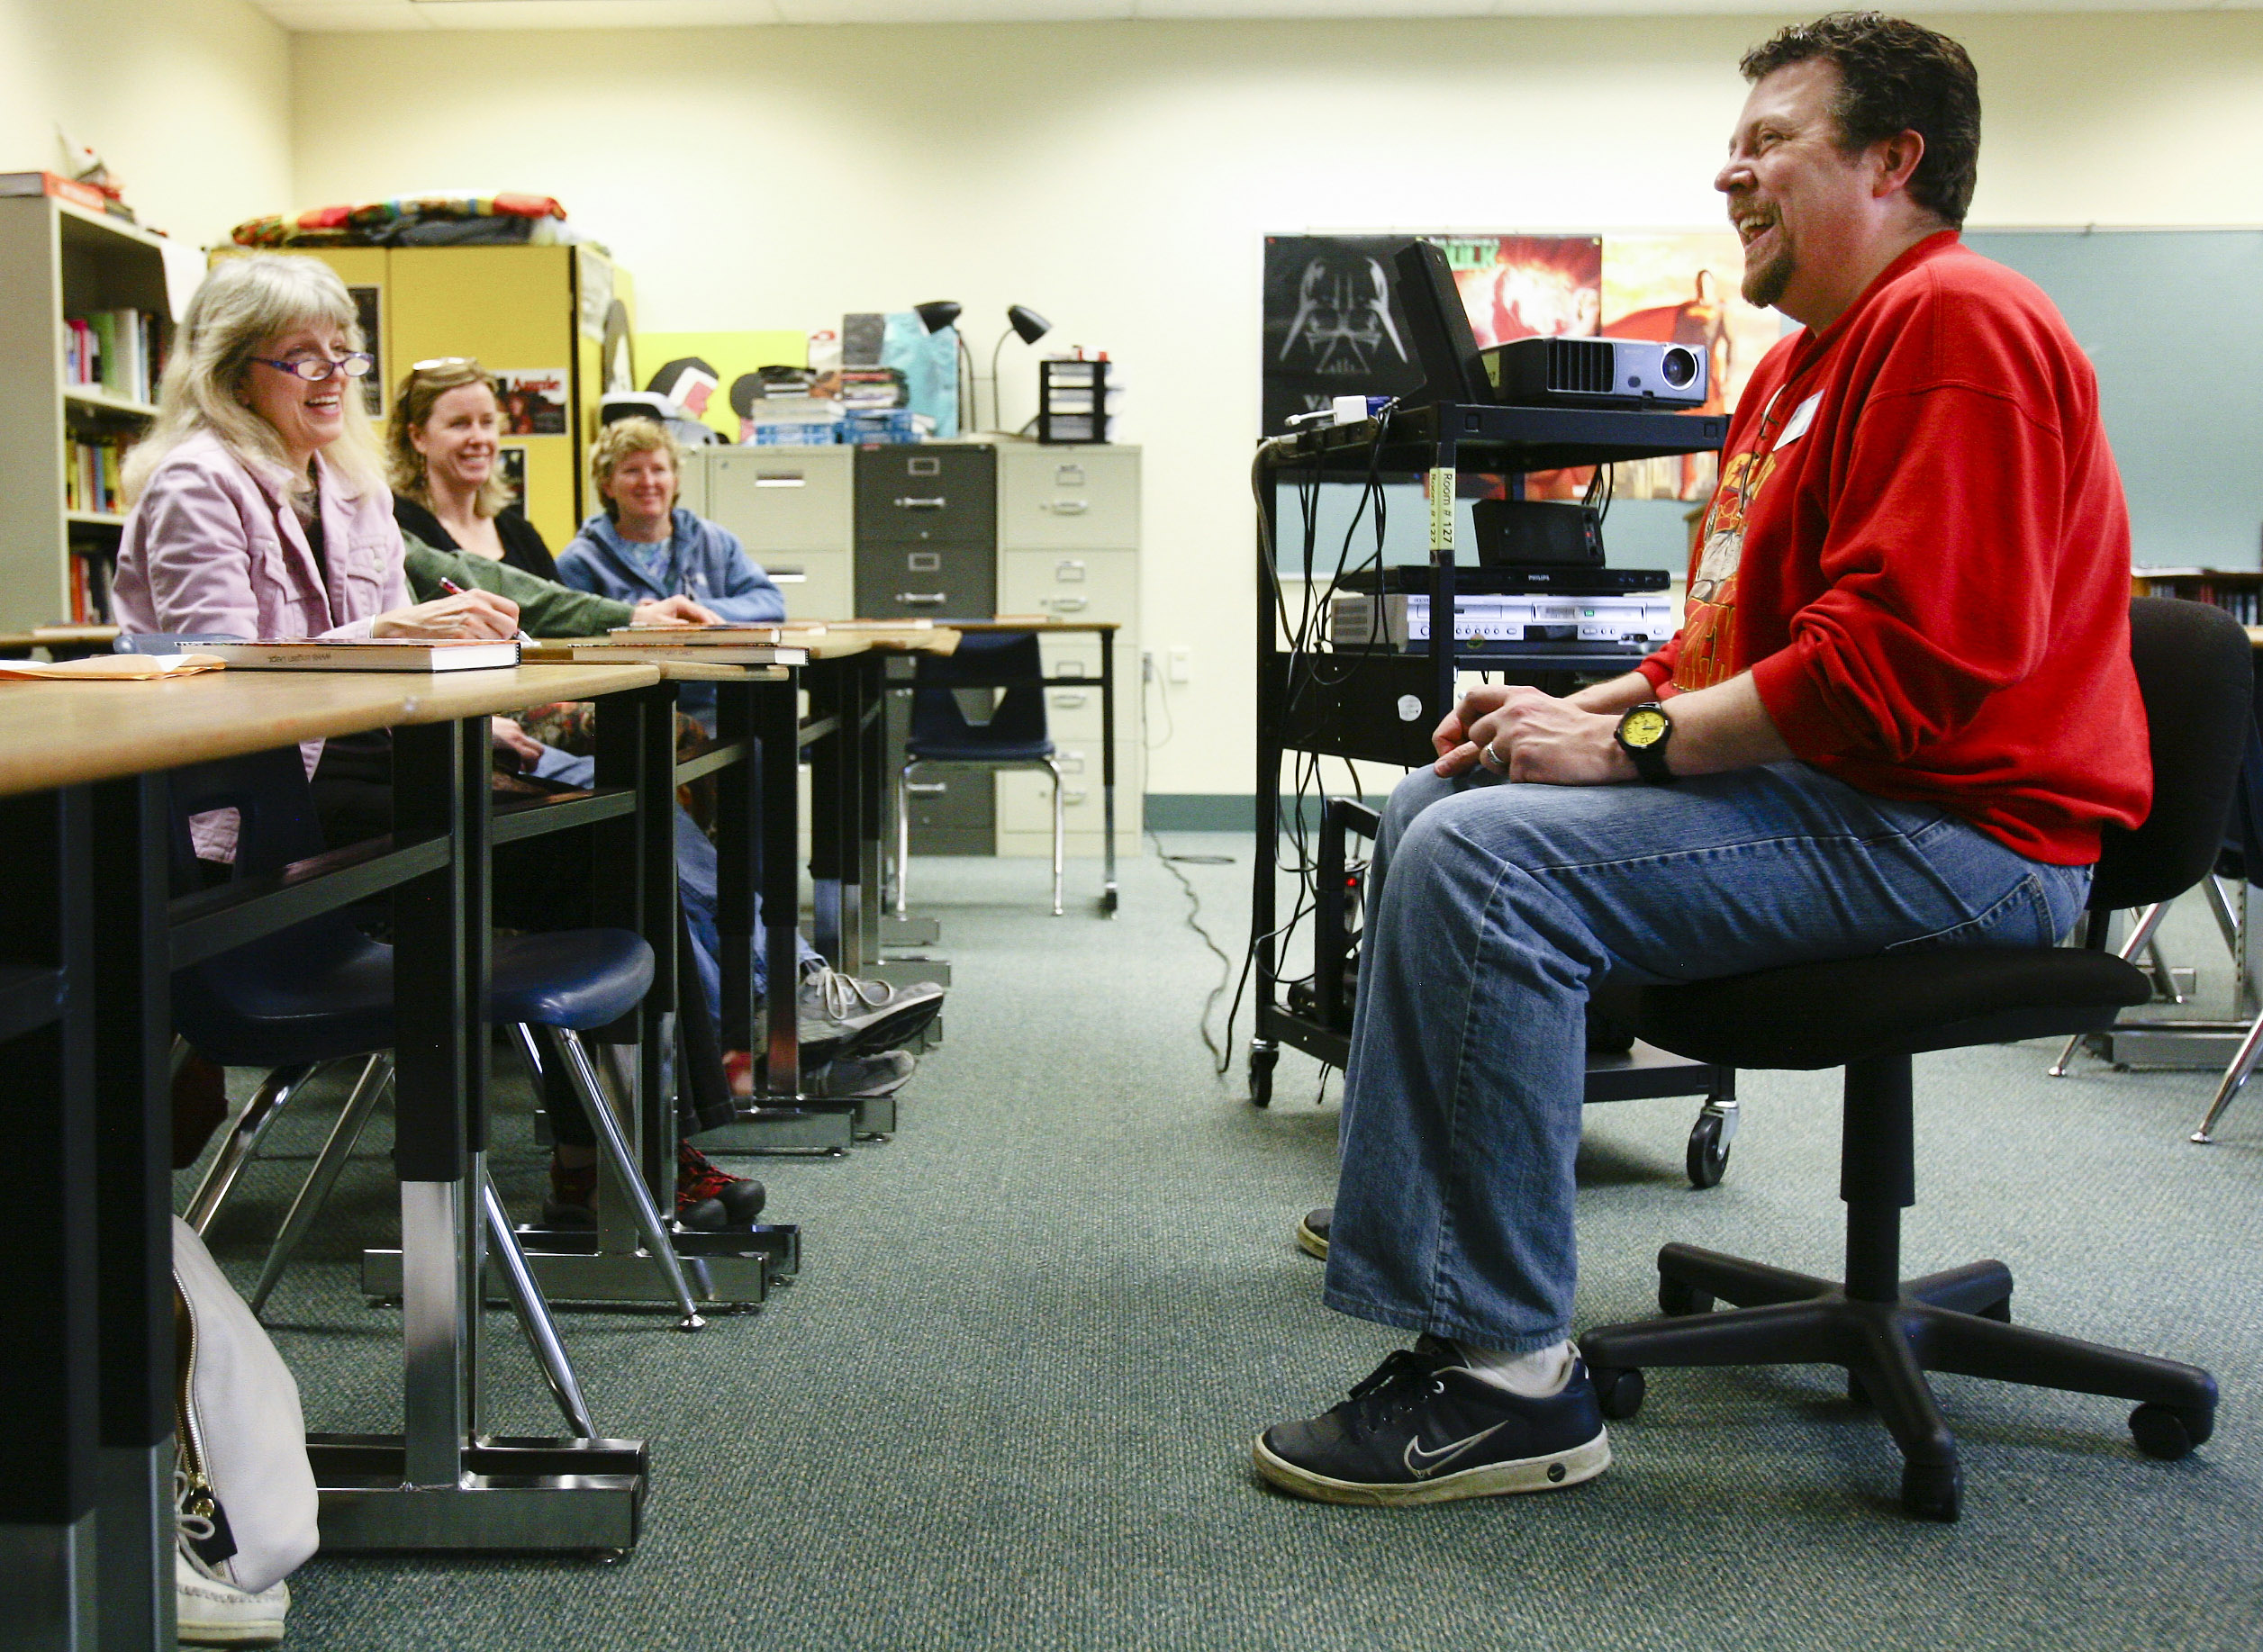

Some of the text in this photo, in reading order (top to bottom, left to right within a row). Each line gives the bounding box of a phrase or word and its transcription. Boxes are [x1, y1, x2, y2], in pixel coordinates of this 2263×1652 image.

[1443, 244, 1498, 269] ULK
[1443, 473, 1453, 506] Room
[1443, 522, 1453, 544] 127
